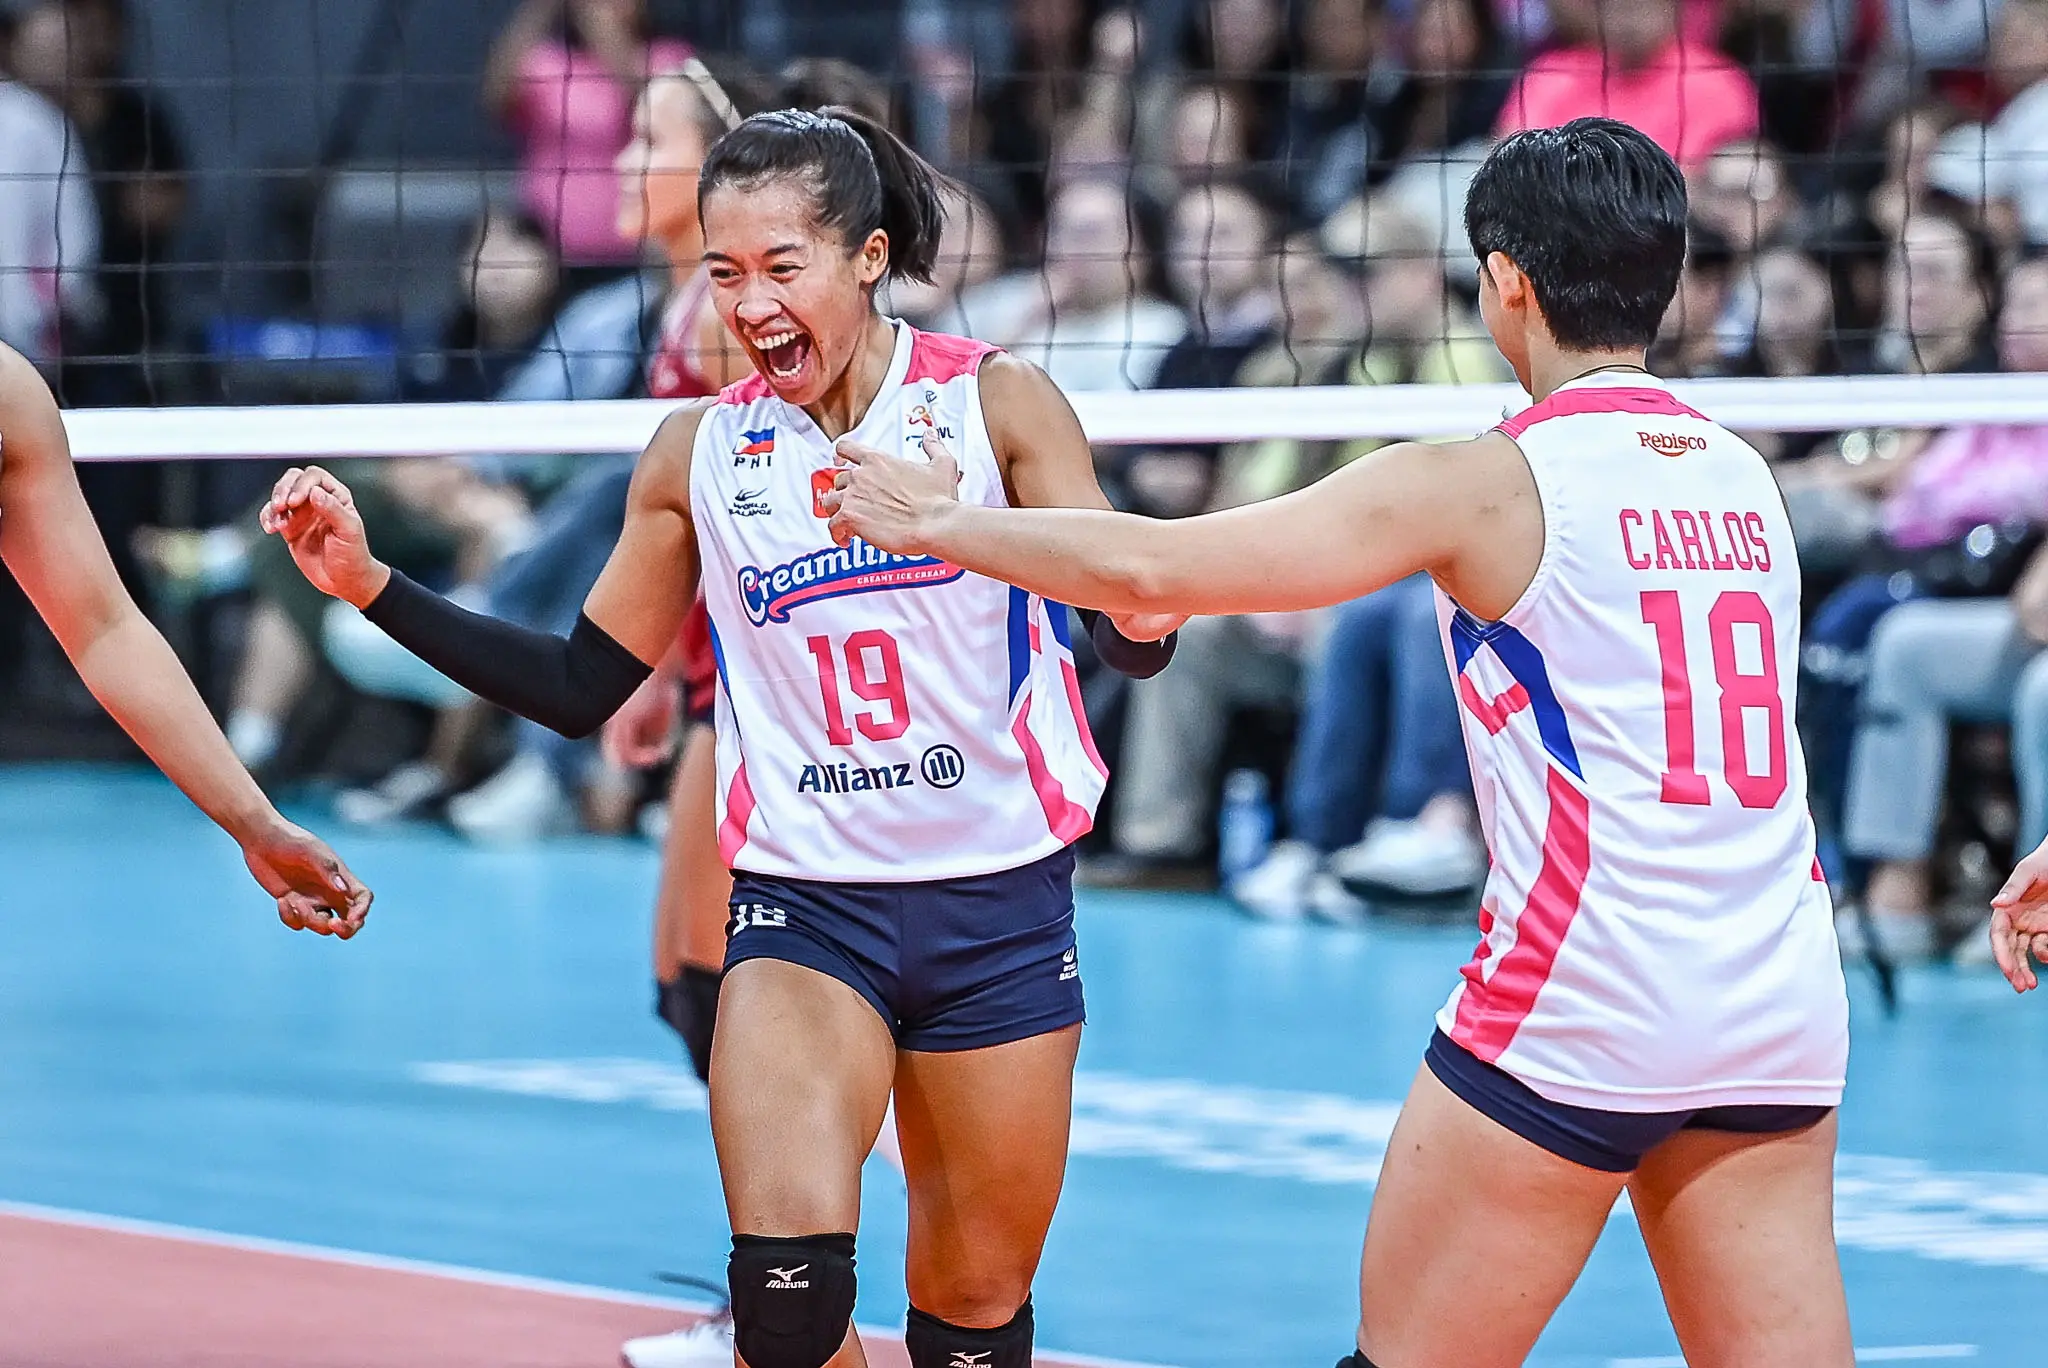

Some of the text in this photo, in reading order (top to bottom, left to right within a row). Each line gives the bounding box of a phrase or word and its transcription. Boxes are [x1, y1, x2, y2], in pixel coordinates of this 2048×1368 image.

[733, 455, 772, 469] PHI
[1636, 431, 1707, 451] Rebisco
[1618, 508, 1771, 573] CARLOS
[739, 535, 929, 625] Creamli
[857, 569, 947, 585] CREAMY ICE CREAM
[806, 628, 911, 746] 19
[1640, 590, 1788, 809] 18
[797, 761, 914, 794] Allianz
